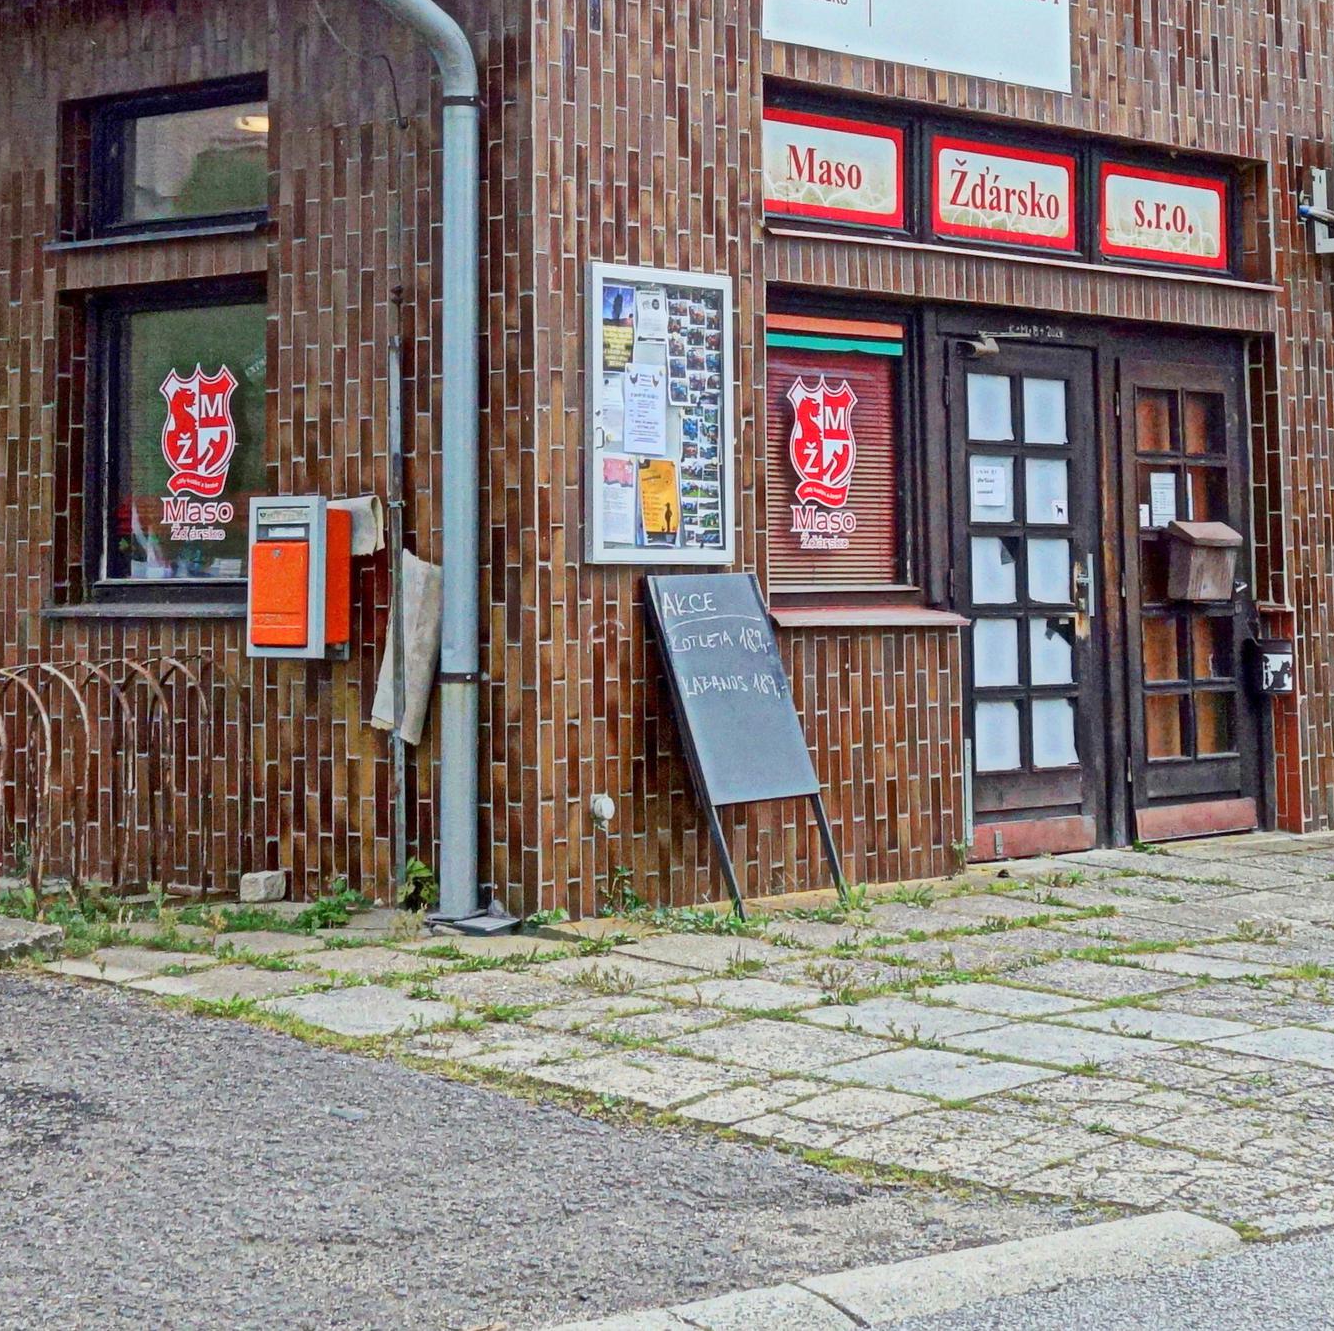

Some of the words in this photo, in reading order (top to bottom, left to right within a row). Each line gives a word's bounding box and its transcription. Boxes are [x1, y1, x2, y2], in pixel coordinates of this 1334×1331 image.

[786, 143, 862, 190] Maso
[948, 157, 1060, 220] Žďársko
[1133, 198, 1195, 235] s.r.o.
[200, 393, 223, 418] M
[824, 406, 845, 430] M
[176, 432, 193, 464] Ž
[803, 442, 819, 473] Ž
[160, 497, 234, 524] Maso
[790, 505, 857, 534] Maso
[661, 591, 717, 619] AKCE
